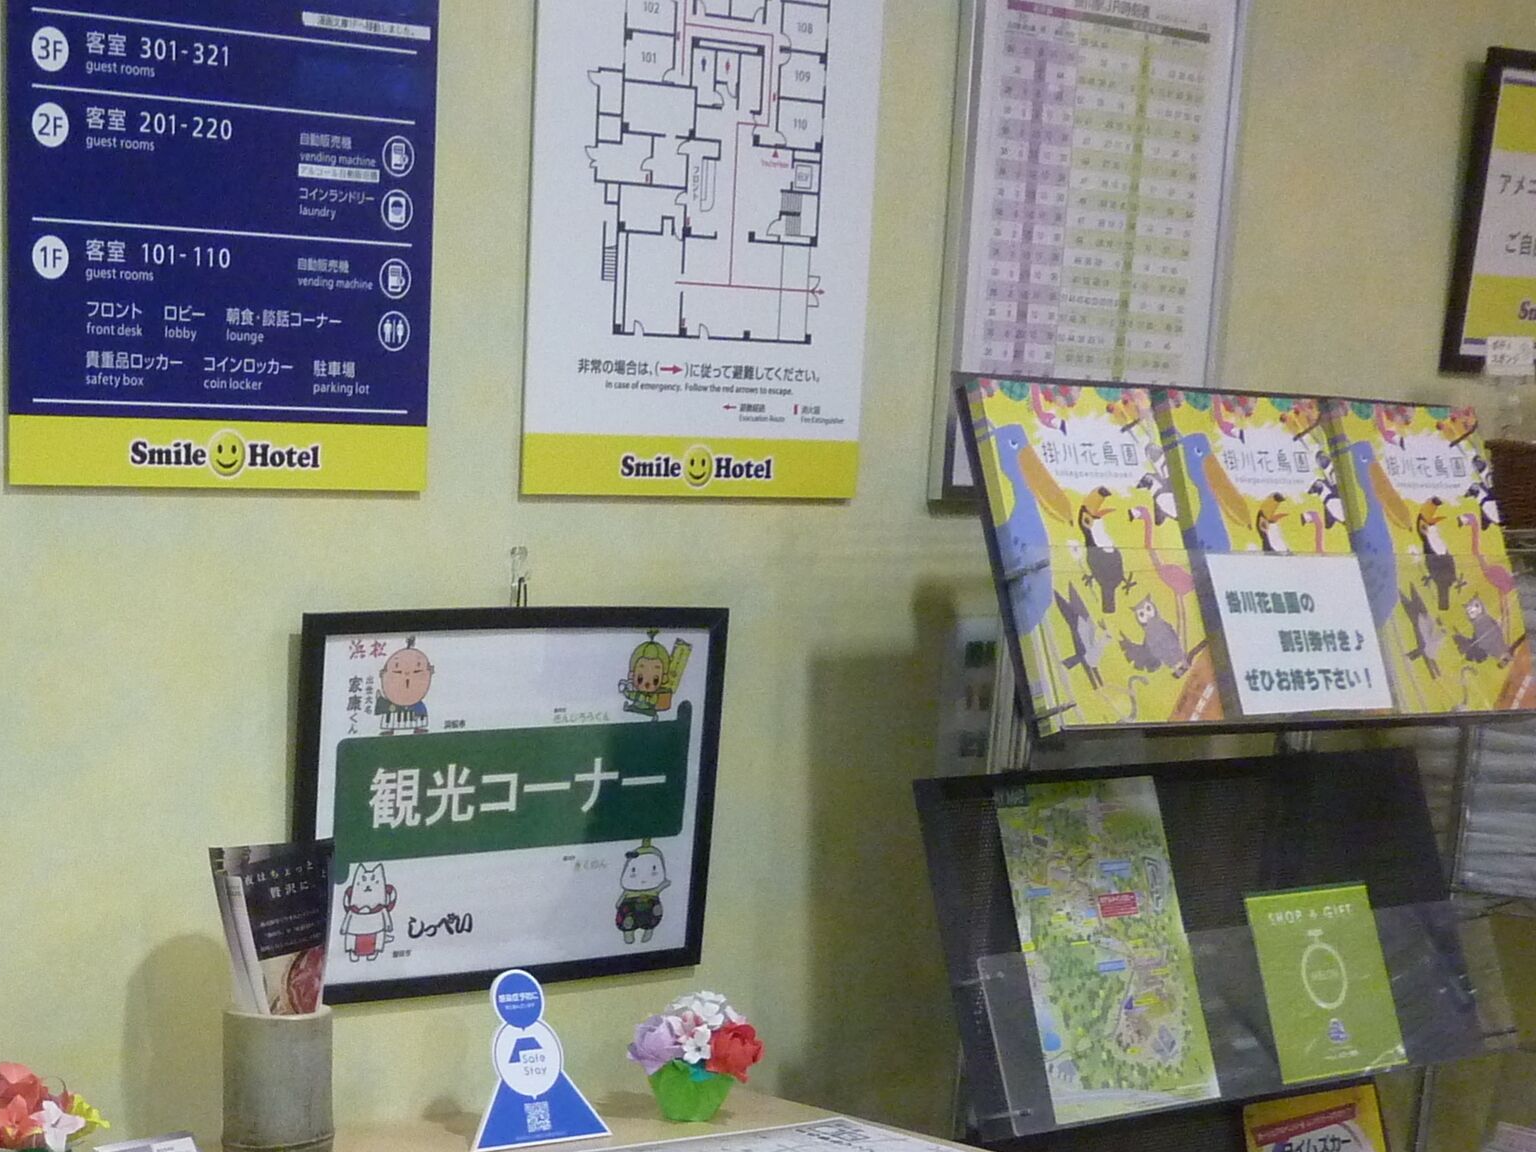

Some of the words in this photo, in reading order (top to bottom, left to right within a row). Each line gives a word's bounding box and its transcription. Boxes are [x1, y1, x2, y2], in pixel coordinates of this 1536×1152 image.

[642, 1, 660, 14] 102
[796, 22, 814, 34] 108
[37, 36, 63, 61] 3F
[86, 30, 127, 57] 客室
[139, 36, 230, 67] 301-321
[641, 52, 657, 64] 101
[86, 61, 117, 74] guest
[120, 63, 155, 77] rooms
[794, 71, 812, 83] 109
[37, 112, 64, 137] 2F
[86, 106, 126, 131] 客室
[139, 112, 233, 141] 201-220
[792, 118, 808, 131] 110
[86, 136, 117, 149] guest
[120, 138, 155, 151] rooms
[299, 132, 352, 150] 自動販売機
[300, 151, 337, 166] vending
[338, 155, 377, 168] machine
[299, 187, 375, 205] コインランドリー
[299, 204, 336, 221] laundry
[39, 246, 64, 268] 1F
[86, 240, 126, 264] 客室
[141, 243, 231, 270] 101-110
[86, 267, 117, 281] guest
[120, 268, 154, 282] rooms
[297, 276, 334, 291] vending
[335, 278, 374, 291] machine
[86, 301, 143, 319] フロント
[164, 305, 206, 323] ロビー
[226, 307, 343, 329] 朝食・談話コーナー
[86, 322, 115, 336] front
[116, 324, 143, 338] desk
[164, 327, 197, 342] lobby
[226, 329, 265, 345] lounge
[86, 350, 184, 371] 貴重品ロッカー
[203, 355, 294, 375] コインロッカー
[313, 360, 356, 379] 駐車場
[86, 372, 122, 388] safety
[123, 374, 144, 387] box
[203, 377, 227, 390] coin
[228, 379, 263, 391] locker
[313, 382, 354, 398] parking
[355, 383, 370, 396] lot
[614, 381, 628, 391] case
[628, 380, 639, 391] of
[684, 382, 709, 394] Follow
[709, 384, 722, 394] the
[722, 385, 735, 395] red
[735, 386, 759, 395] arrows
[759, 386, 768, 395] to
[768, 387, 794, 397] escape.
[130, 439, 207, 467] Smile
[248, 442, 321, 469] Hotel
[621, 455, 682, 478] Smile
[713, 456, 773, 480] Hotel
[346, 675, 364, 735] 家康くん
[369, 757, 667, 830] 観光コーナー
[1268, 910, 1303, 926] SHOP
[1322, 903, 1353, 919] GIFT
[522, 1053, 546, 1065] Safe
[523, 1066, 548, 1077] Stay
